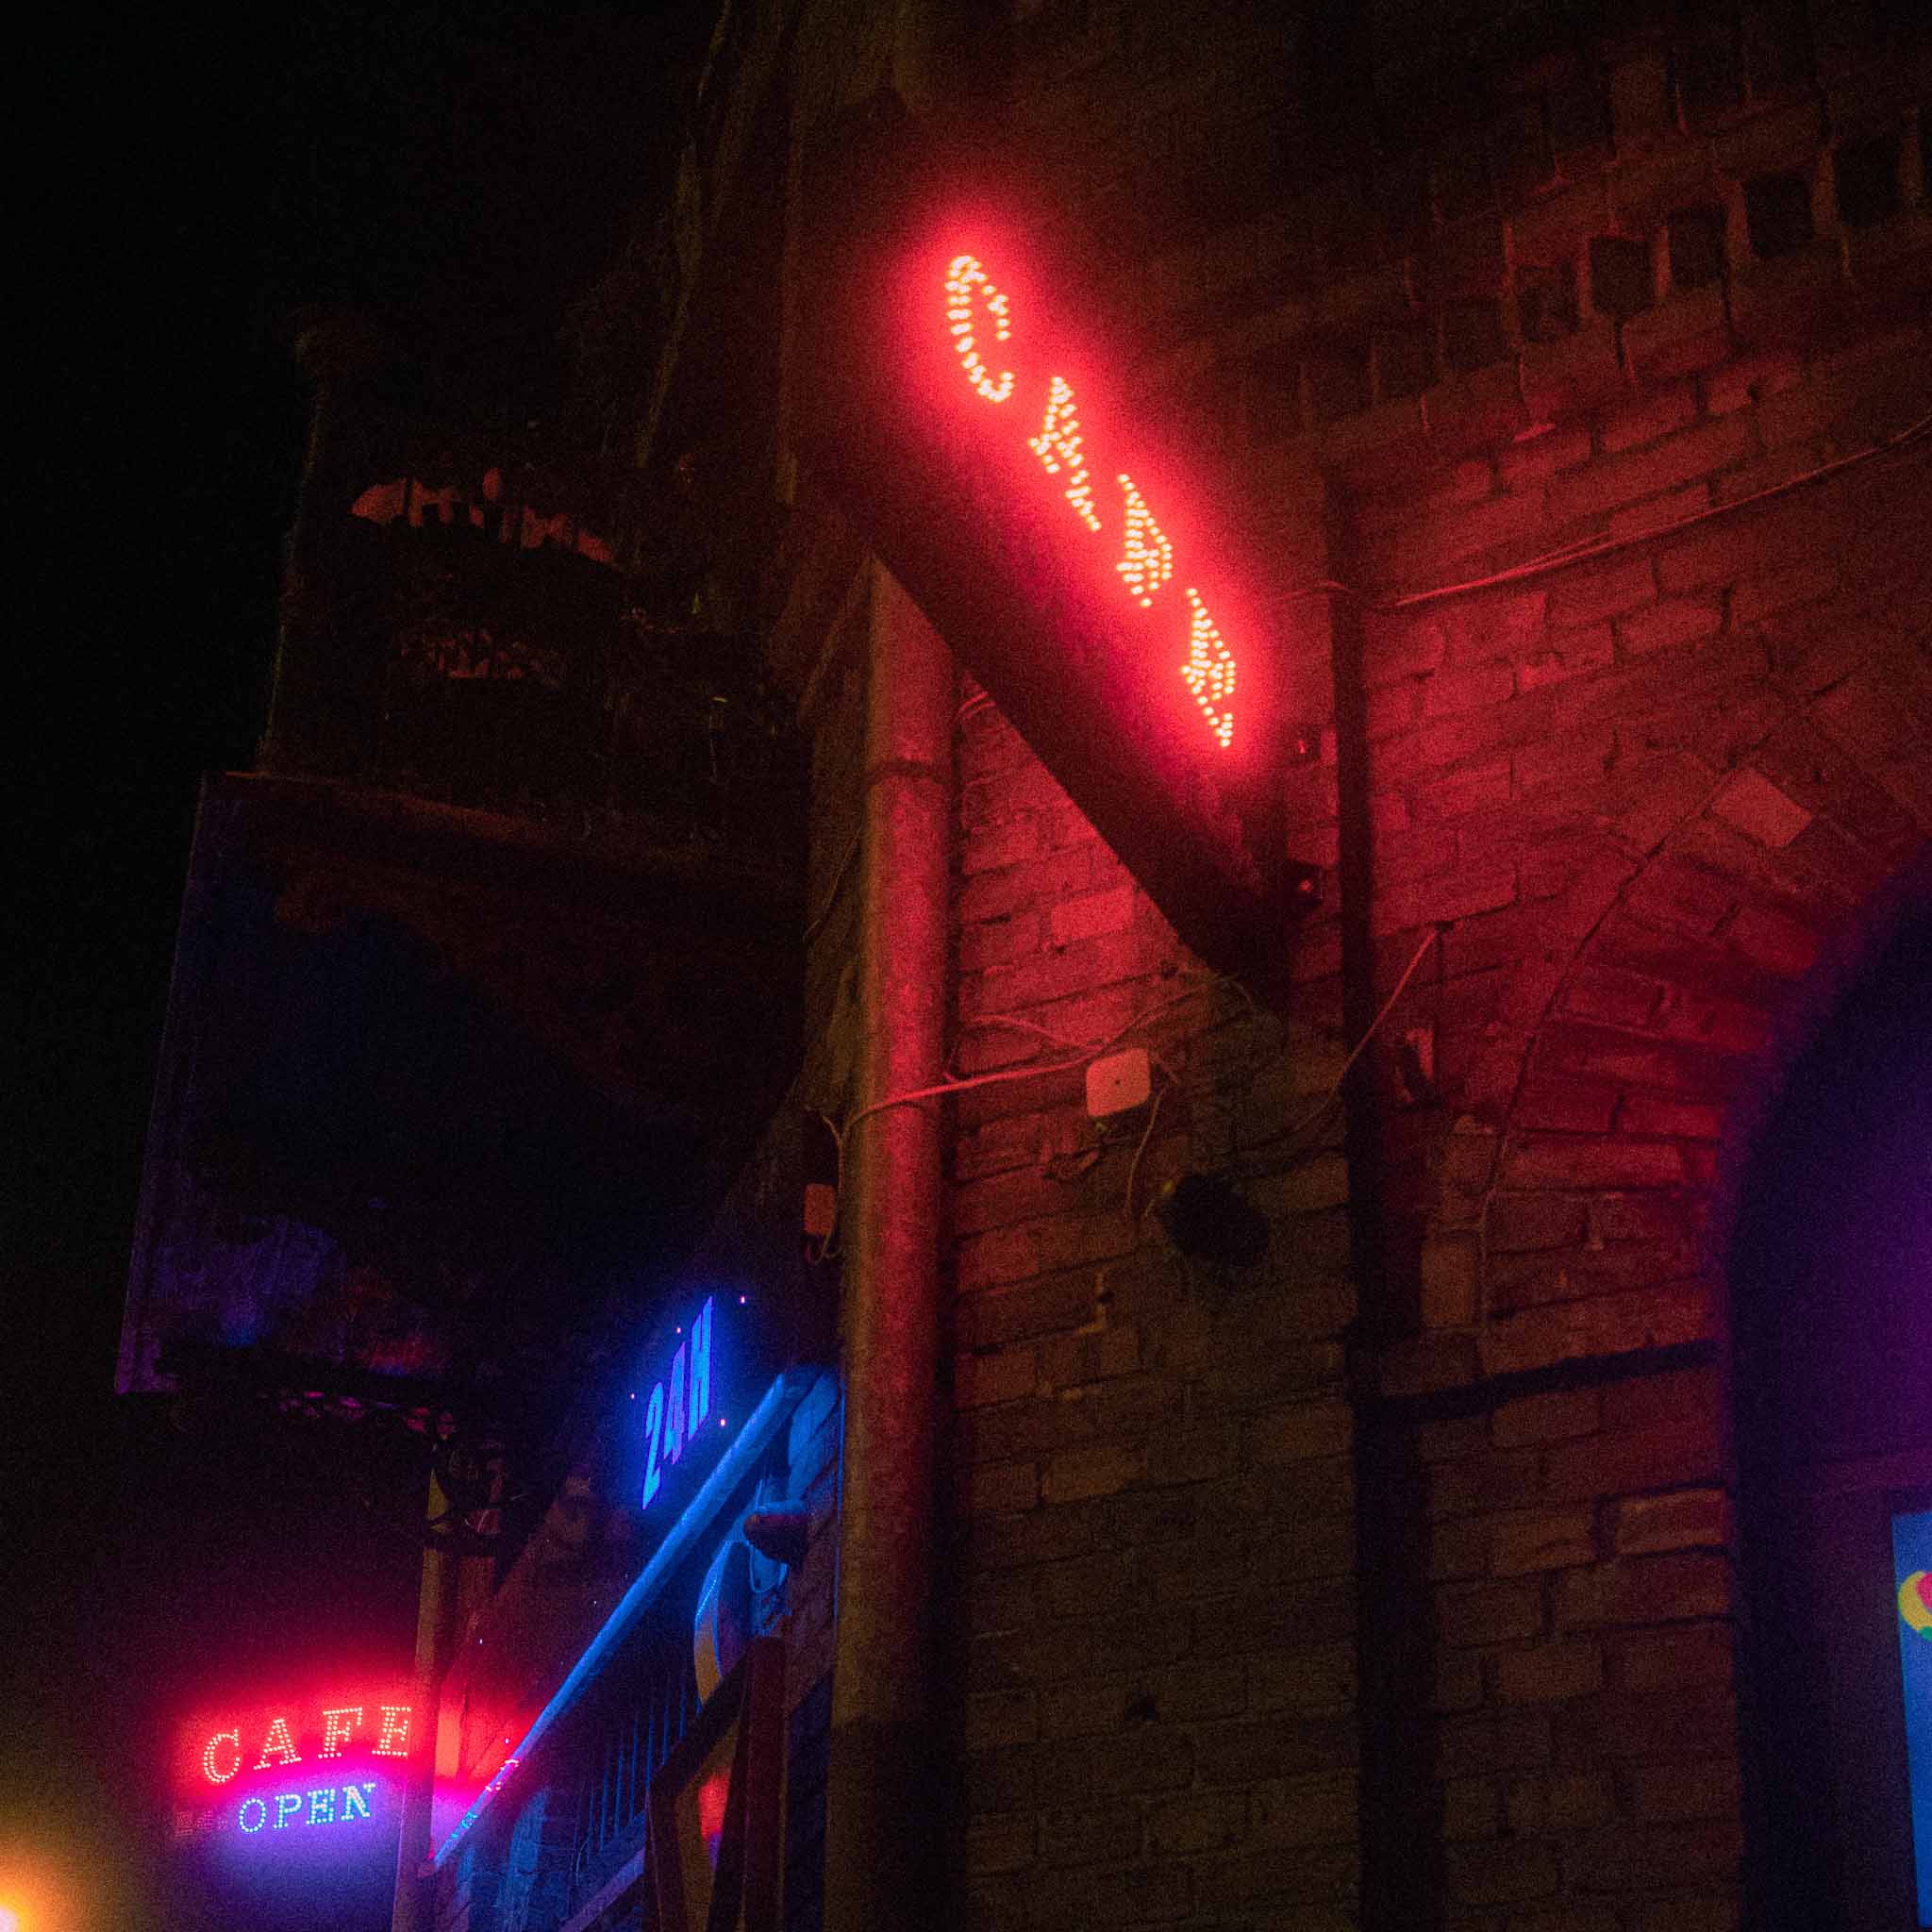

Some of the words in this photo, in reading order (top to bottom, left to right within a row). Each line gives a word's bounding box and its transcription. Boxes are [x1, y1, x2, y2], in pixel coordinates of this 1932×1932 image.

[642, 1295, 713, 1509] 24H
[202, 1706, 412, 1784] CAFE
[239, 1783, 376, 1833] OPEN
